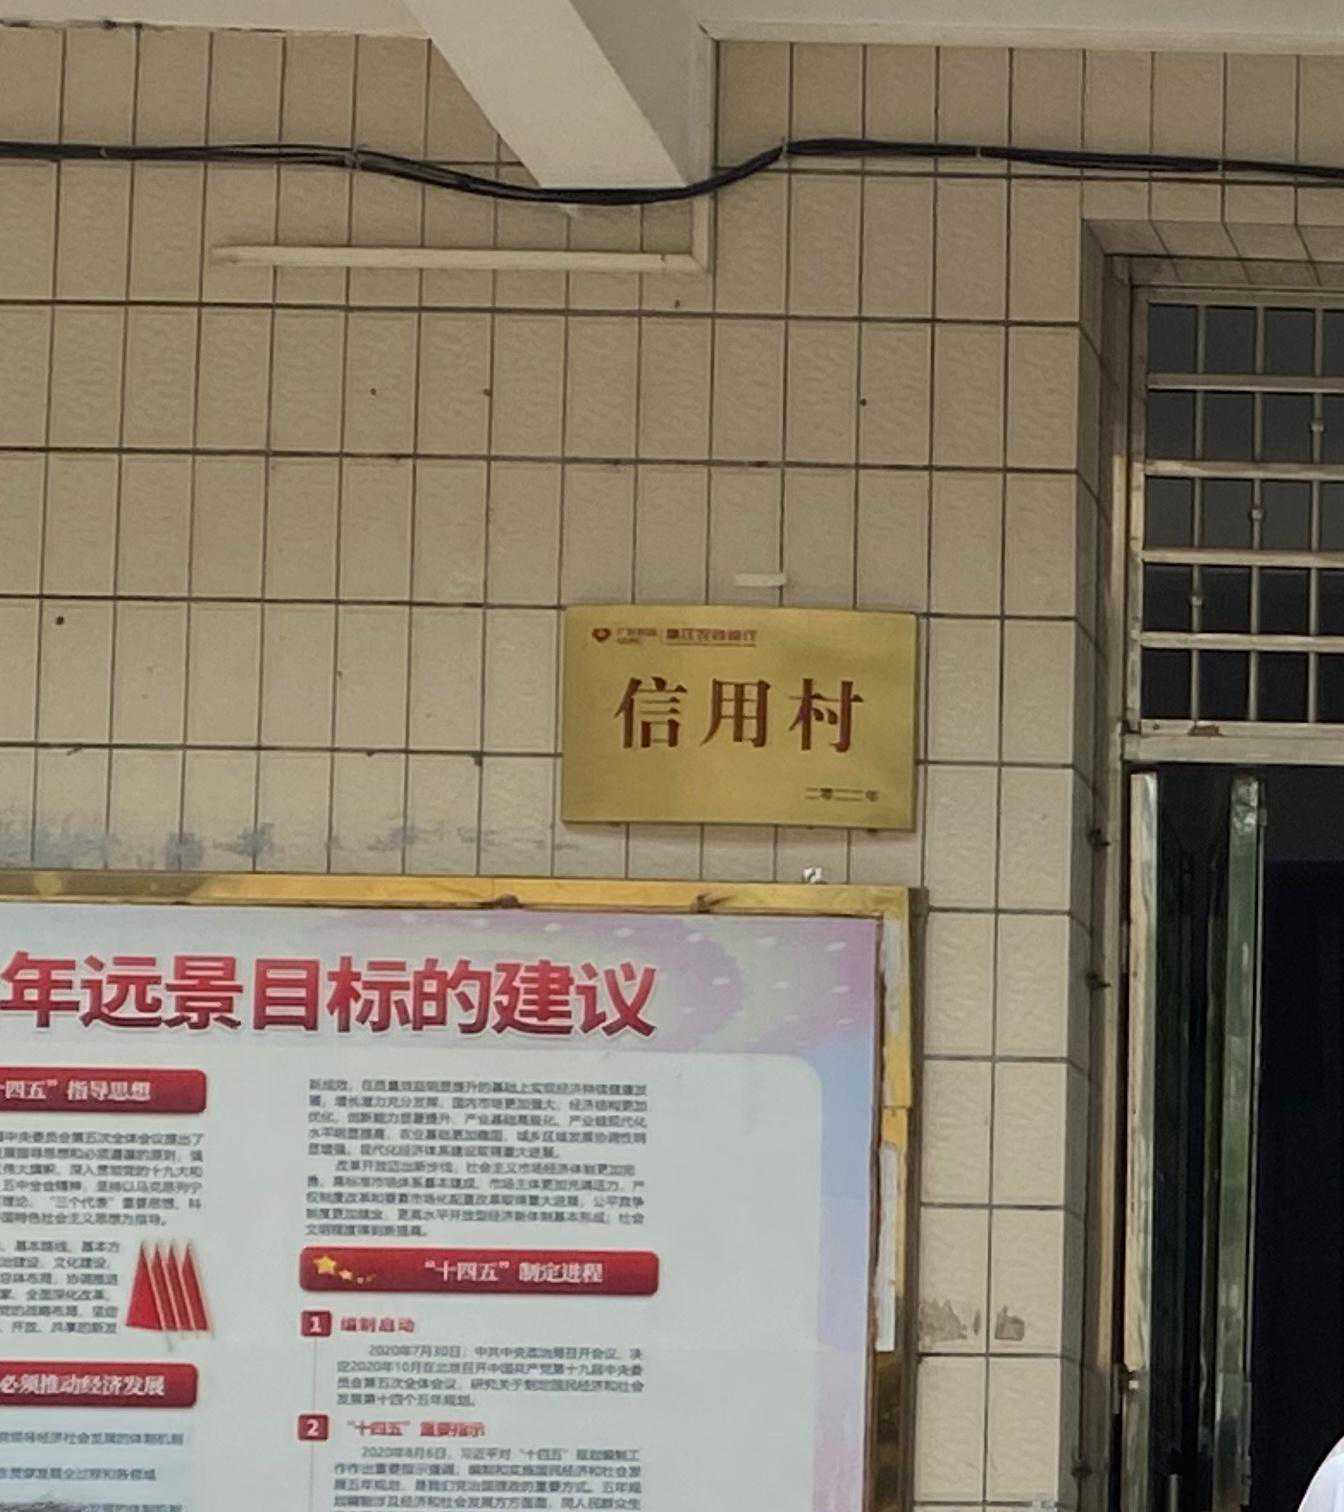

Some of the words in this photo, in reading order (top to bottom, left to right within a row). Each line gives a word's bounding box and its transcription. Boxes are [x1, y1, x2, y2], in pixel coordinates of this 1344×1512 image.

[613, 676, 864, 753] 信用村
[0, 950, 657, 1037] 年远景目标的建议
